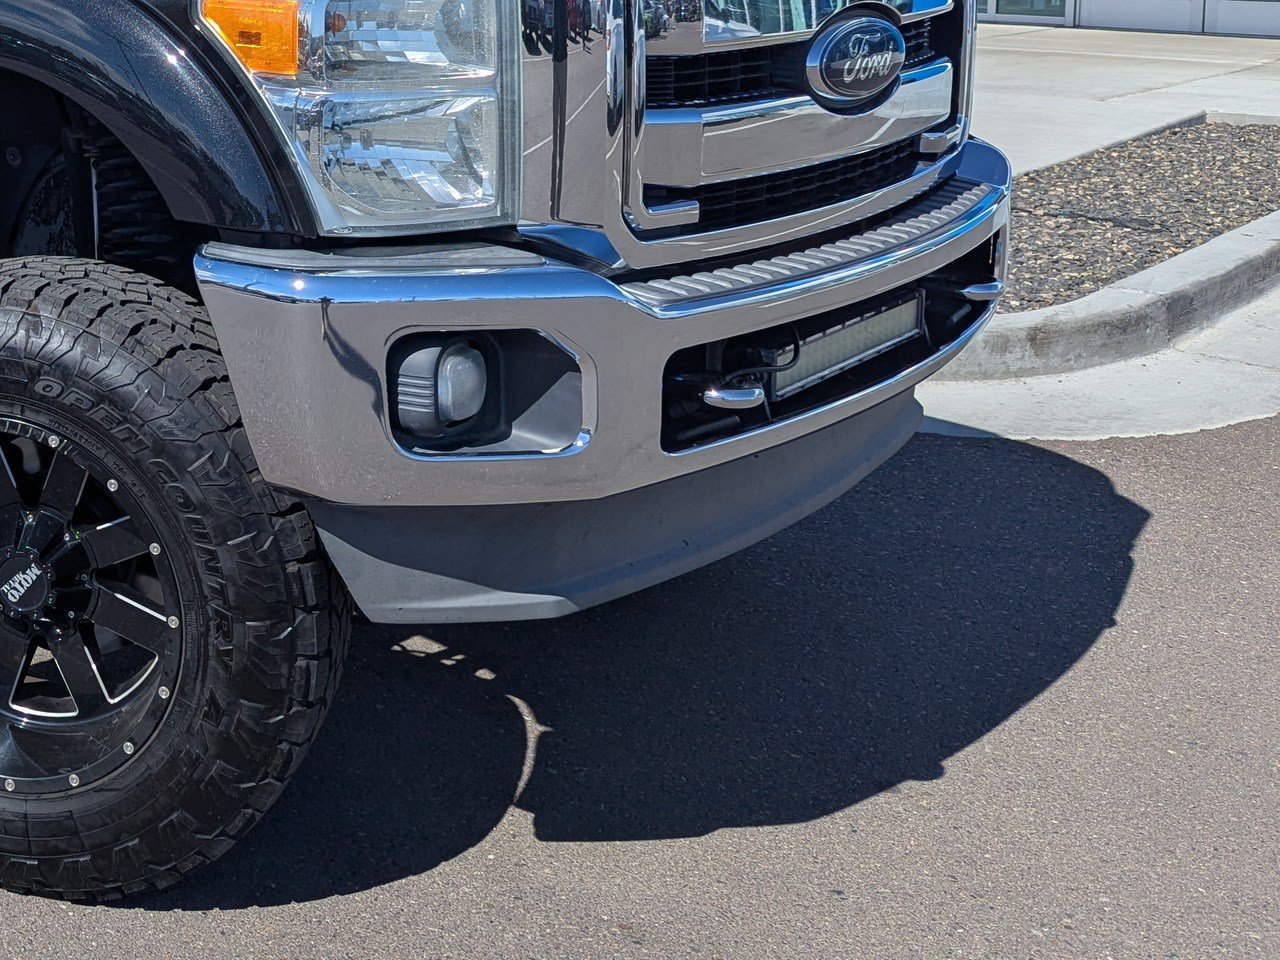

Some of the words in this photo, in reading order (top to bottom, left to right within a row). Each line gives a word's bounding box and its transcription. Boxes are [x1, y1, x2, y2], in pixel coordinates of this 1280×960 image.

[843, 33, 894, 83] Ford
[33, 375, 151, 455] OPEN
[146, 458, 234, 680] COUNTRY
[7, 562, 43, 603] MOTO
